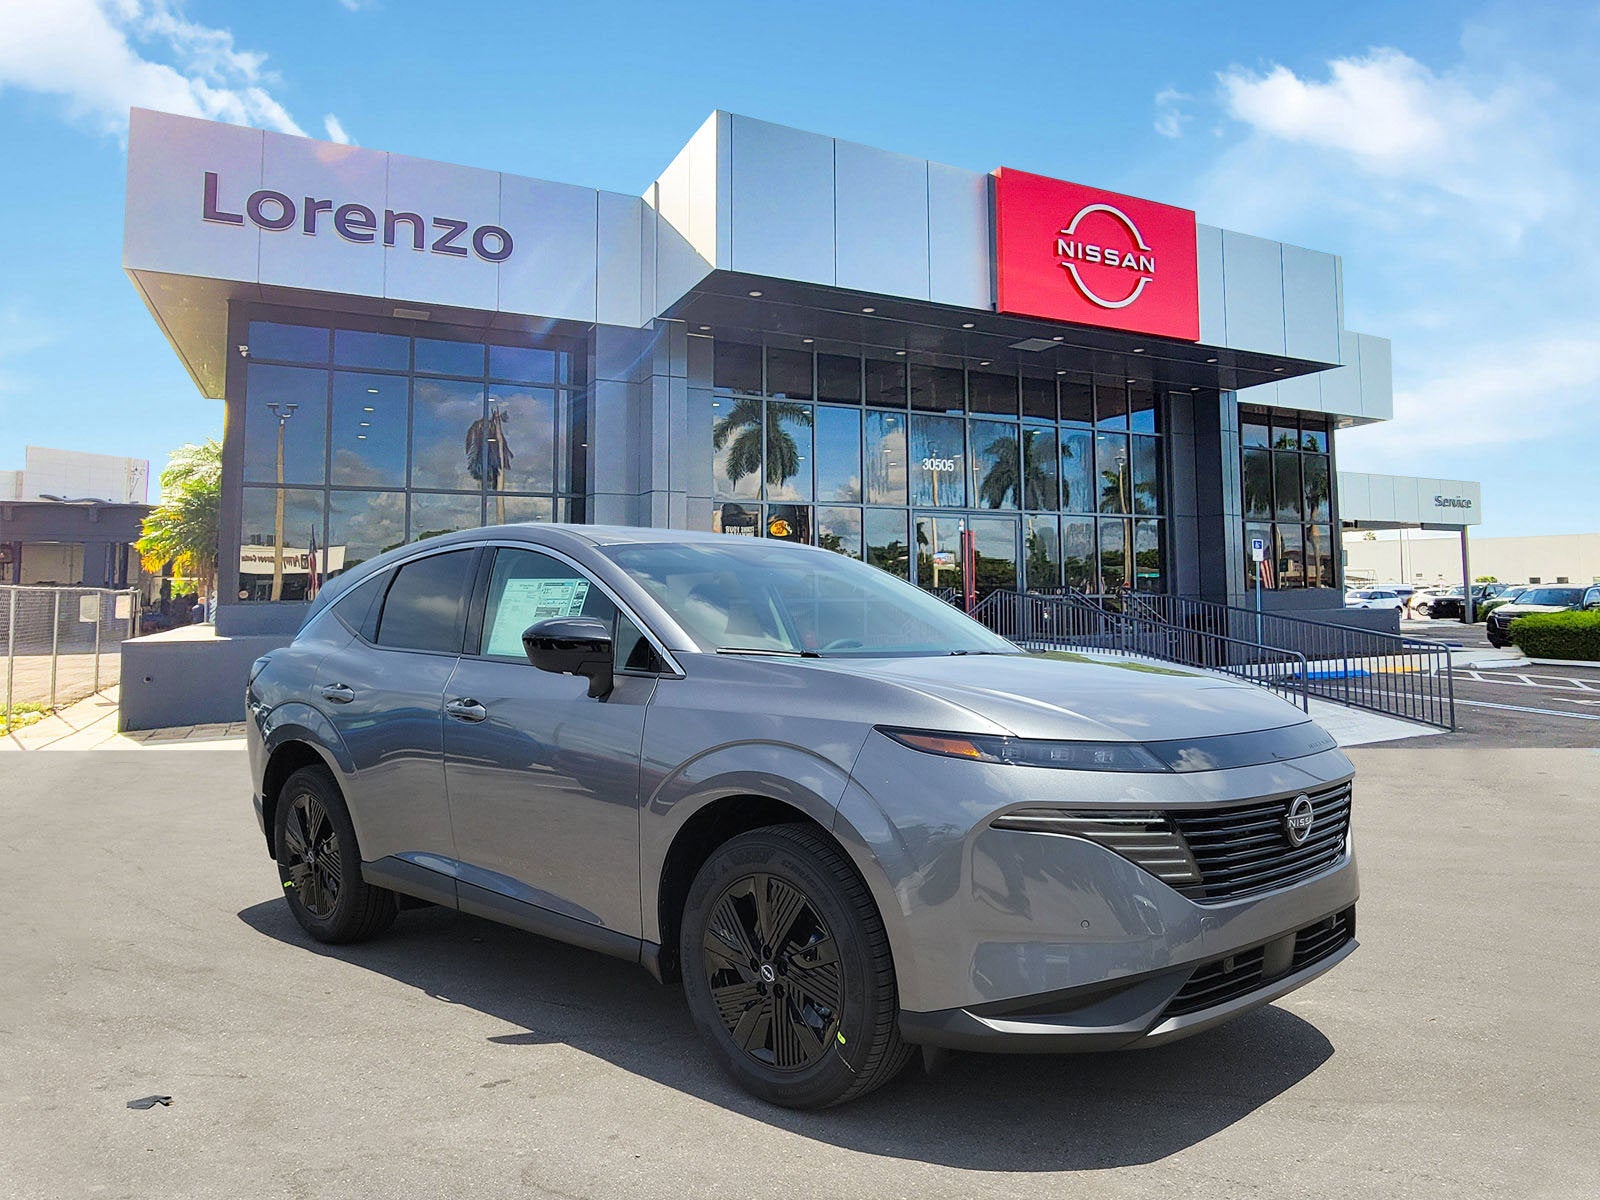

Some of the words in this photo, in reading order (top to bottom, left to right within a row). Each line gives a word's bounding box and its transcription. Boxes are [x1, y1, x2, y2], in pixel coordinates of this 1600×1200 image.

[202, 171, 514, 262] Lorenzo
[1057, 238, 1155, 273] NISSAN
[922, 458, 954, 472] 30505
[1434, 495, 1472, 508] Service
